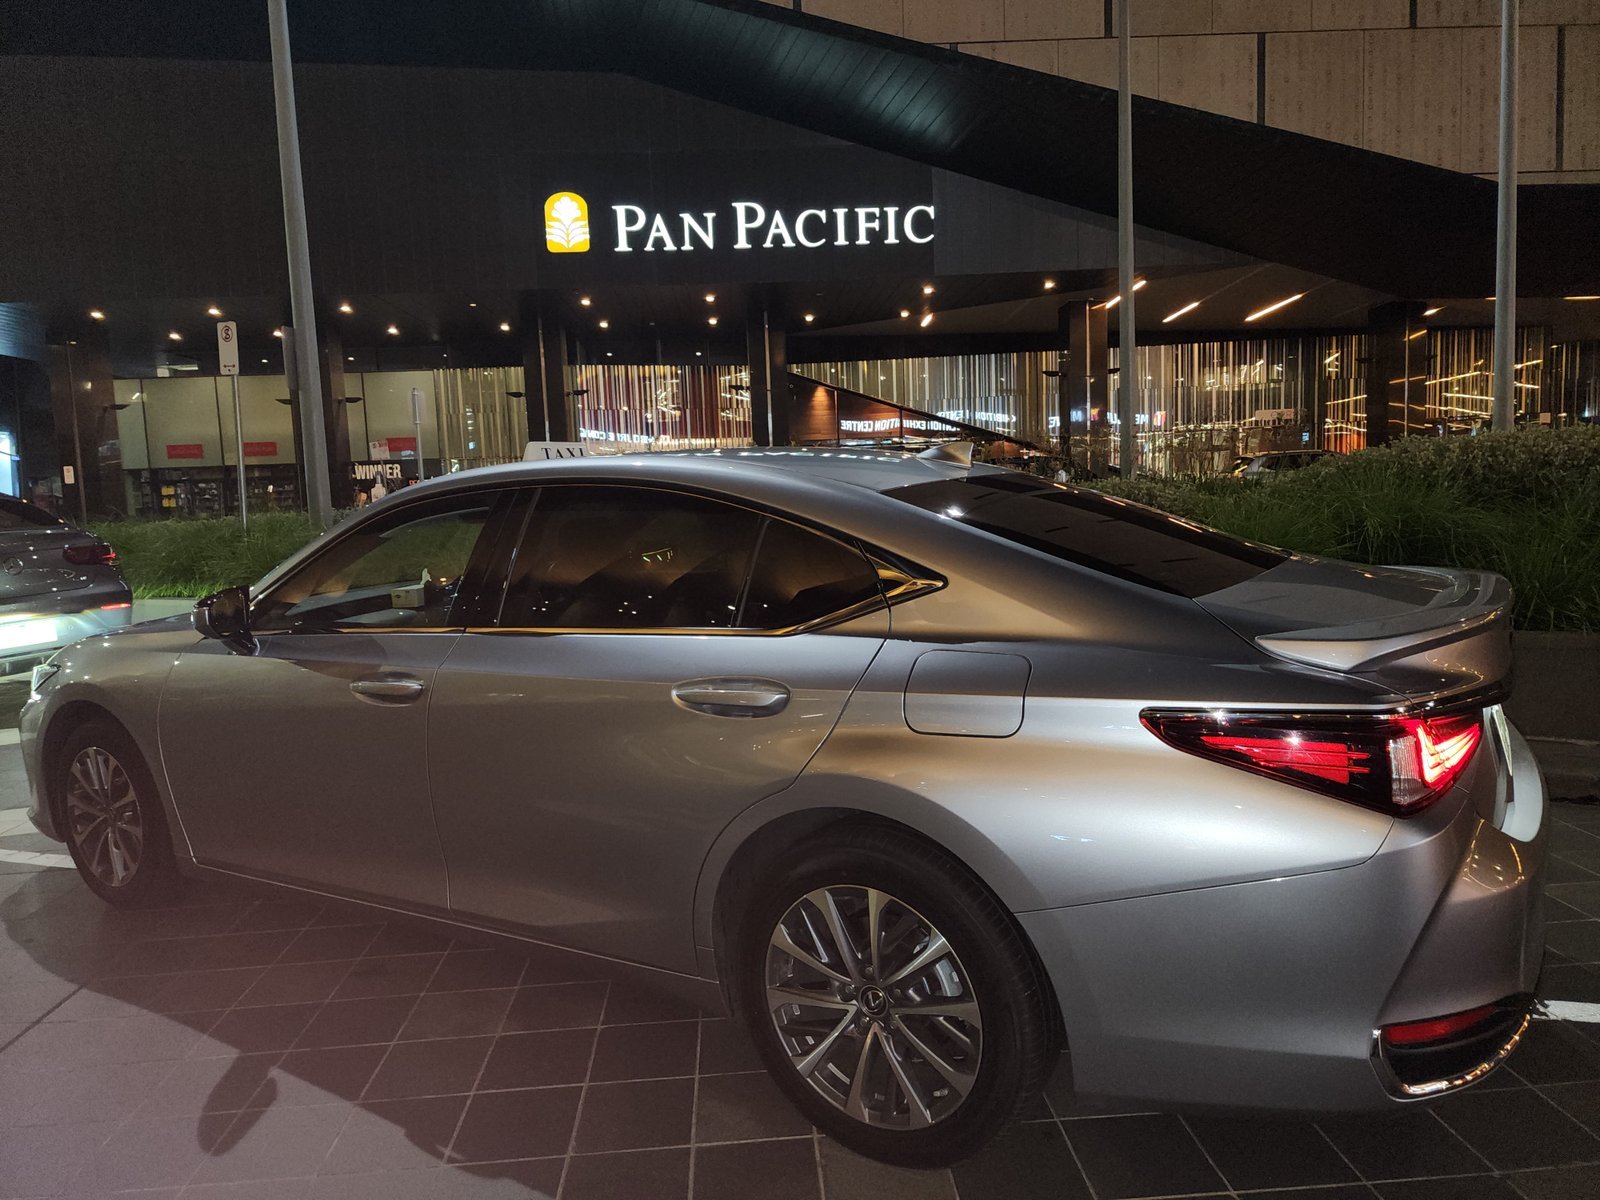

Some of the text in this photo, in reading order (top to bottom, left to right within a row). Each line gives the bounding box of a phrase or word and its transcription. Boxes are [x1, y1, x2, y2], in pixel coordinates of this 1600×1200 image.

[611, 201, 936, 253] PAN PACIFIC
[541, 447, 585, 460] TAXI
